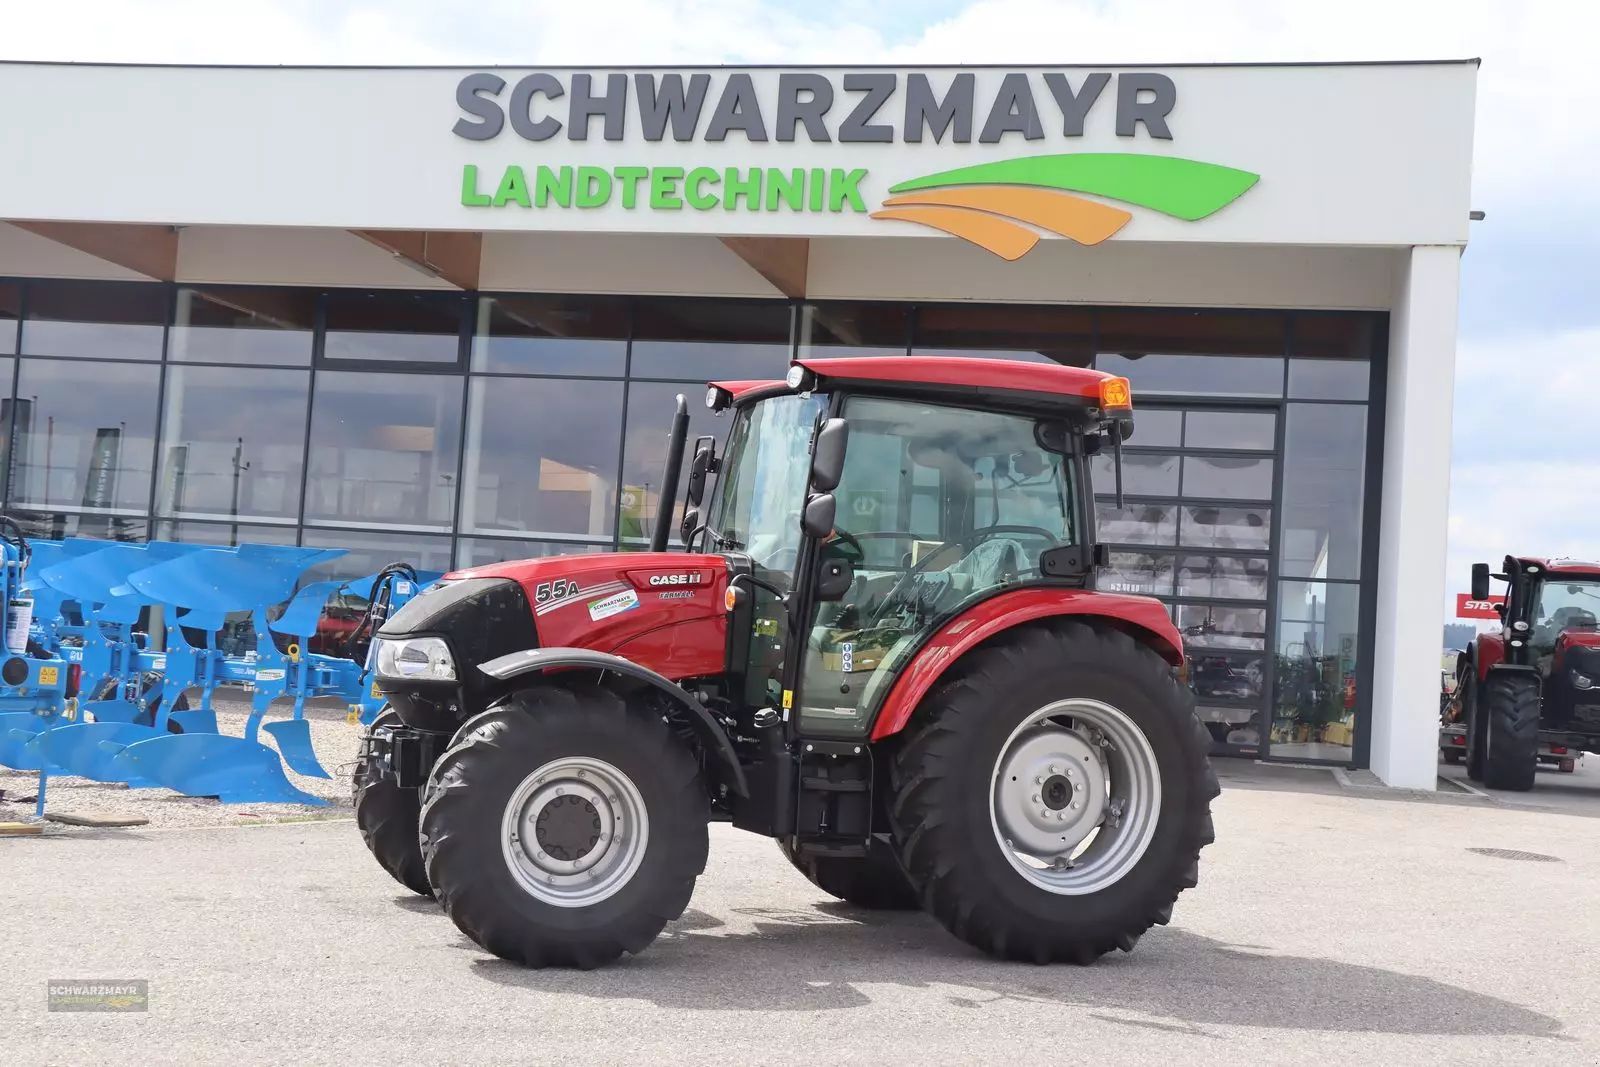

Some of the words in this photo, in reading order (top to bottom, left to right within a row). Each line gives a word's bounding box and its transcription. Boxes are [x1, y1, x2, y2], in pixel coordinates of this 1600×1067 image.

[451, 73, 1177, 144] SCHWARZMAYR
[460, 164, 869, 212] LANDTECHNIK
[650, 575, 688, 585] CASE
[535, 579, 580, 603] 55A
[658, 591, 694, 599] FARMALL
[593, 595, 631, 610] SCHWARZMAYR
[1464, 601, 1504, 610] STEY
